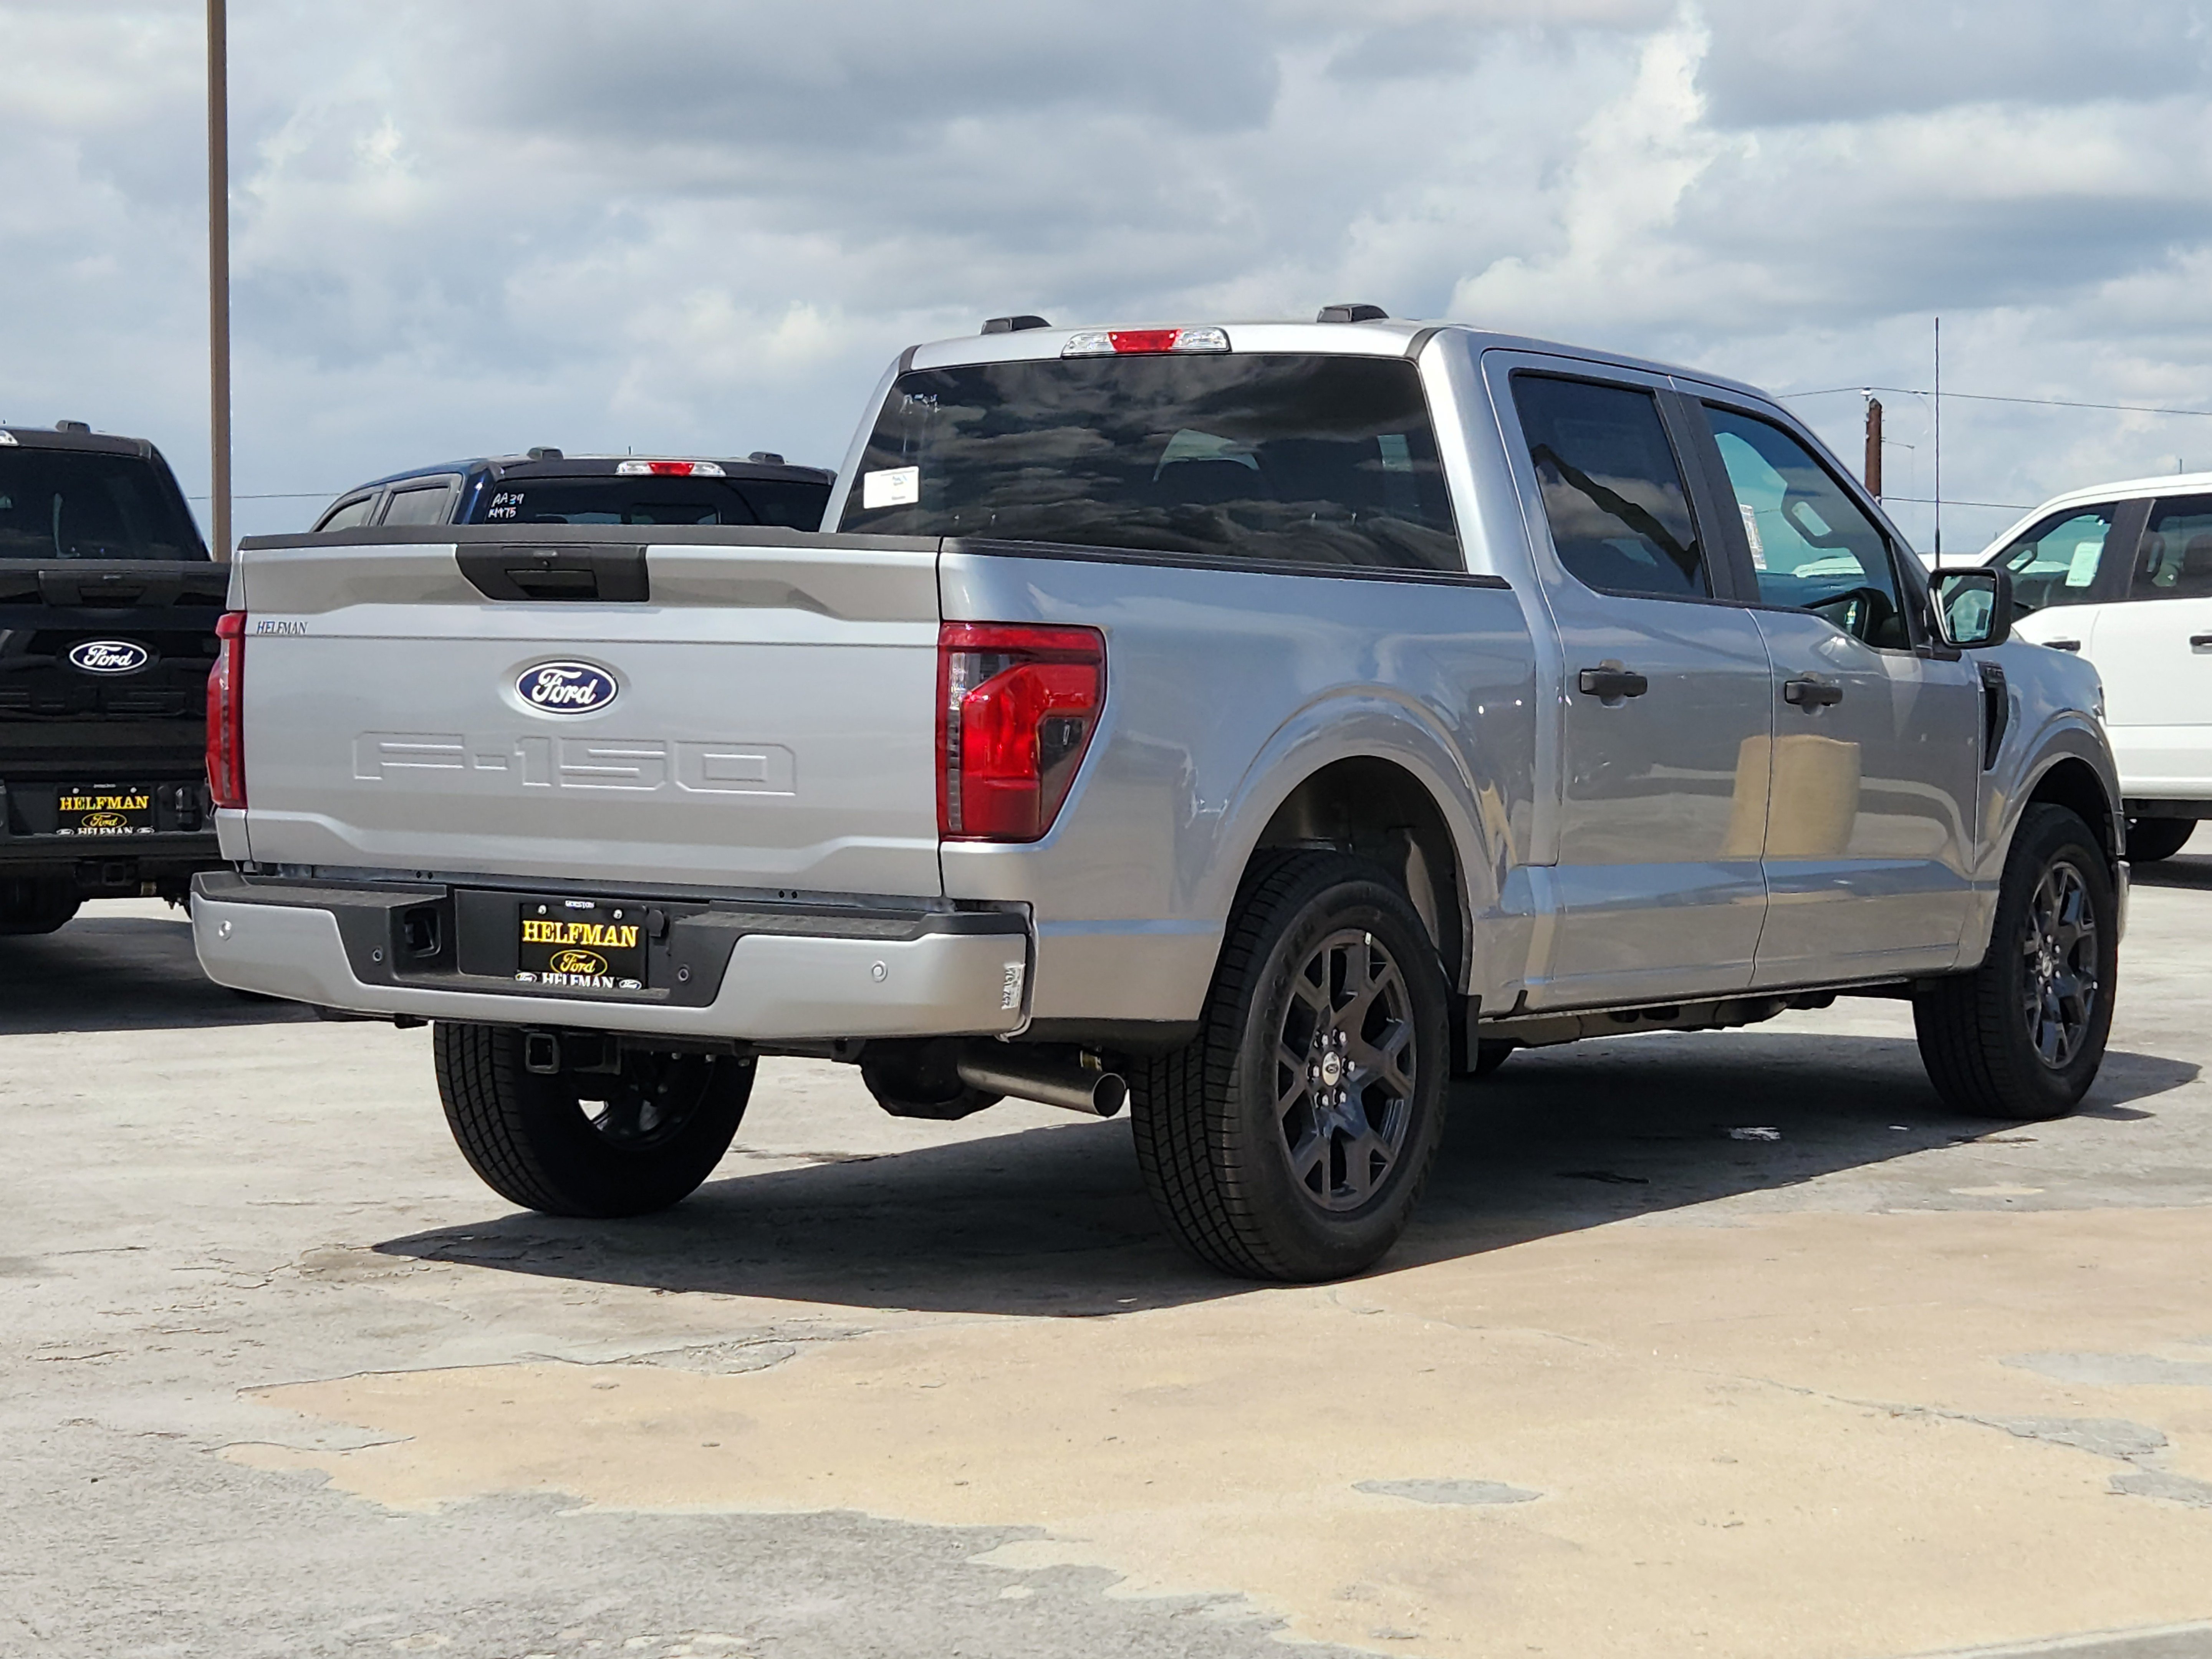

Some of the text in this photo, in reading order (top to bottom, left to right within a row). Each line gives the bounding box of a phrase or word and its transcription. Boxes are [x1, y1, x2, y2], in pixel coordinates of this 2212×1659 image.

[257, 621, 308, 634] HELFMAN
[353, 730, 797, 796] F-150
[59, 796, 149, 811] HELFMAN
[522, 920, 639, 948] HELFMAN
